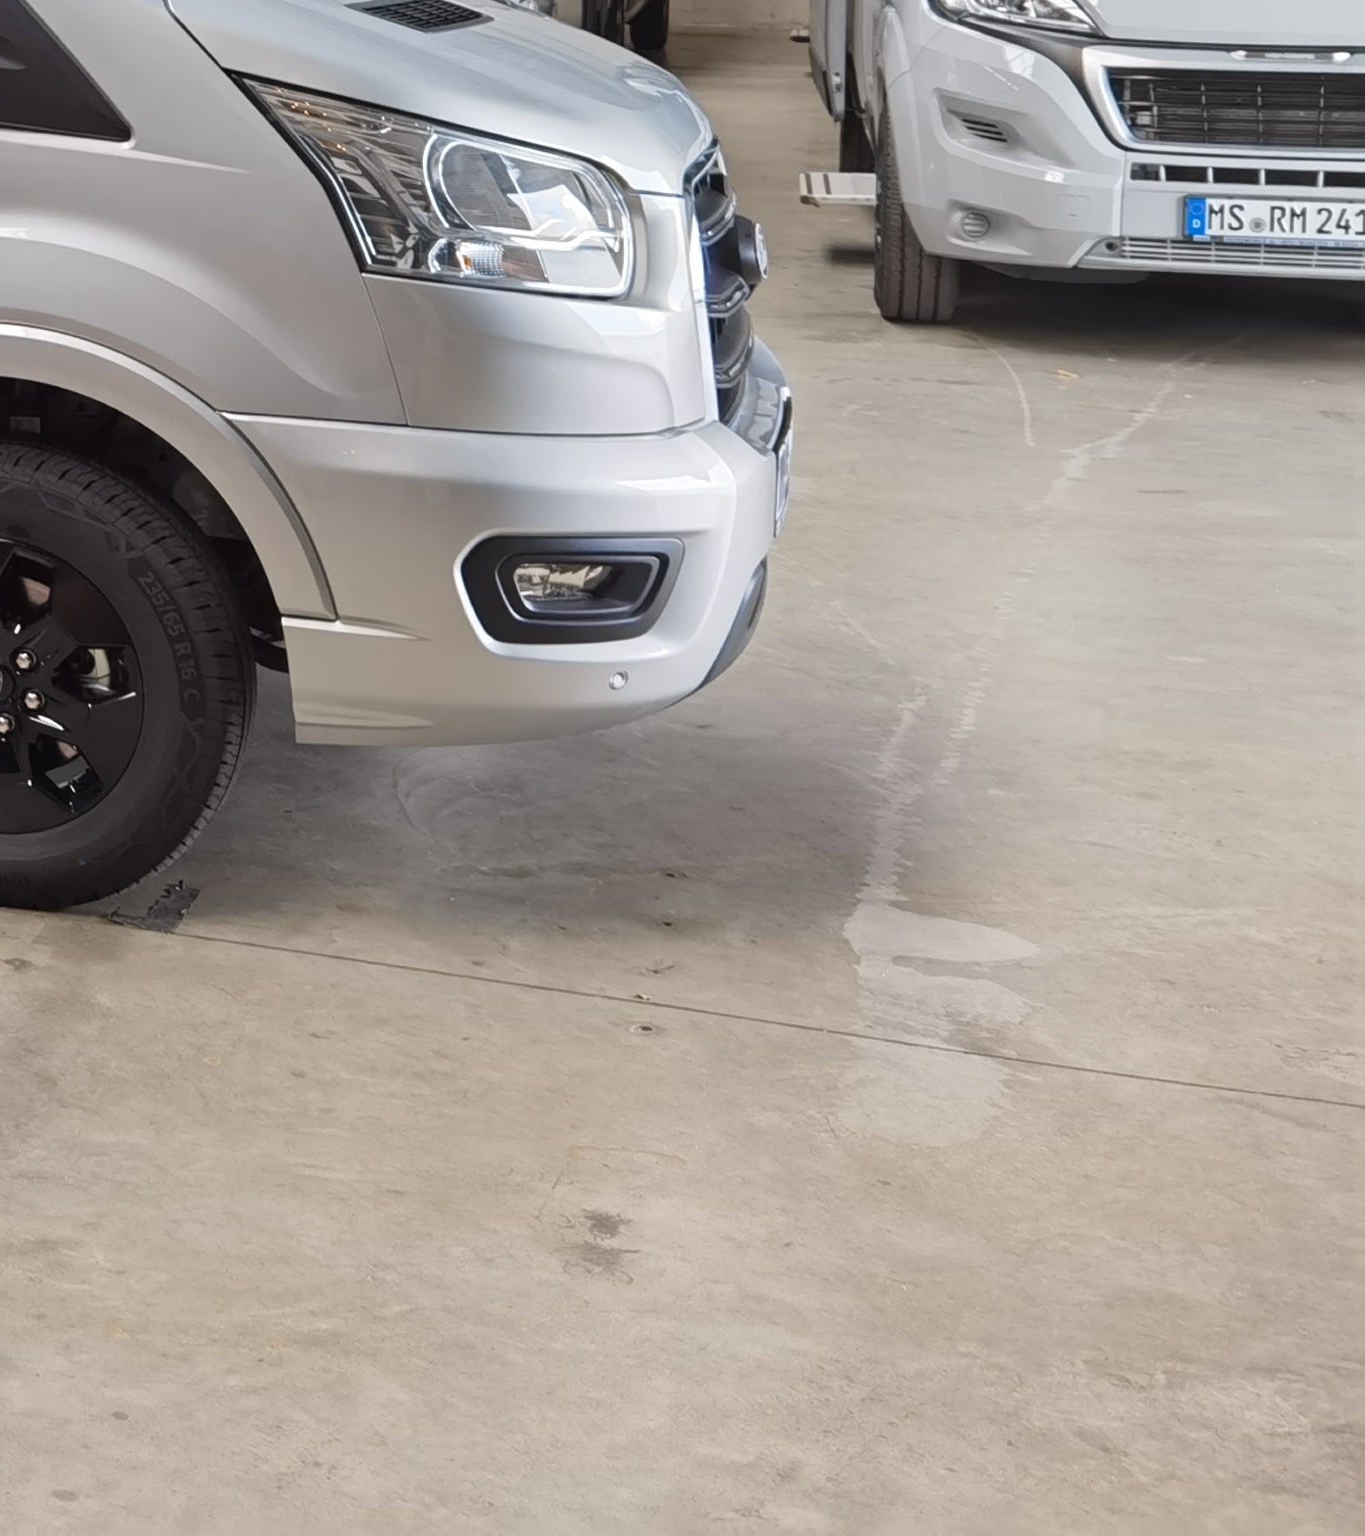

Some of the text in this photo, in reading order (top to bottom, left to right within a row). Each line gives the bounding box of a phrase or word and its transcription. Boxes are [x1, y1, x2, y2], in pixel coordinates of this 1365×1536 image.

[1207, 203, 1246, 232] MS
[1269, 205, 1308, 234] RM
[137, 570, 186, 637] 235/65
